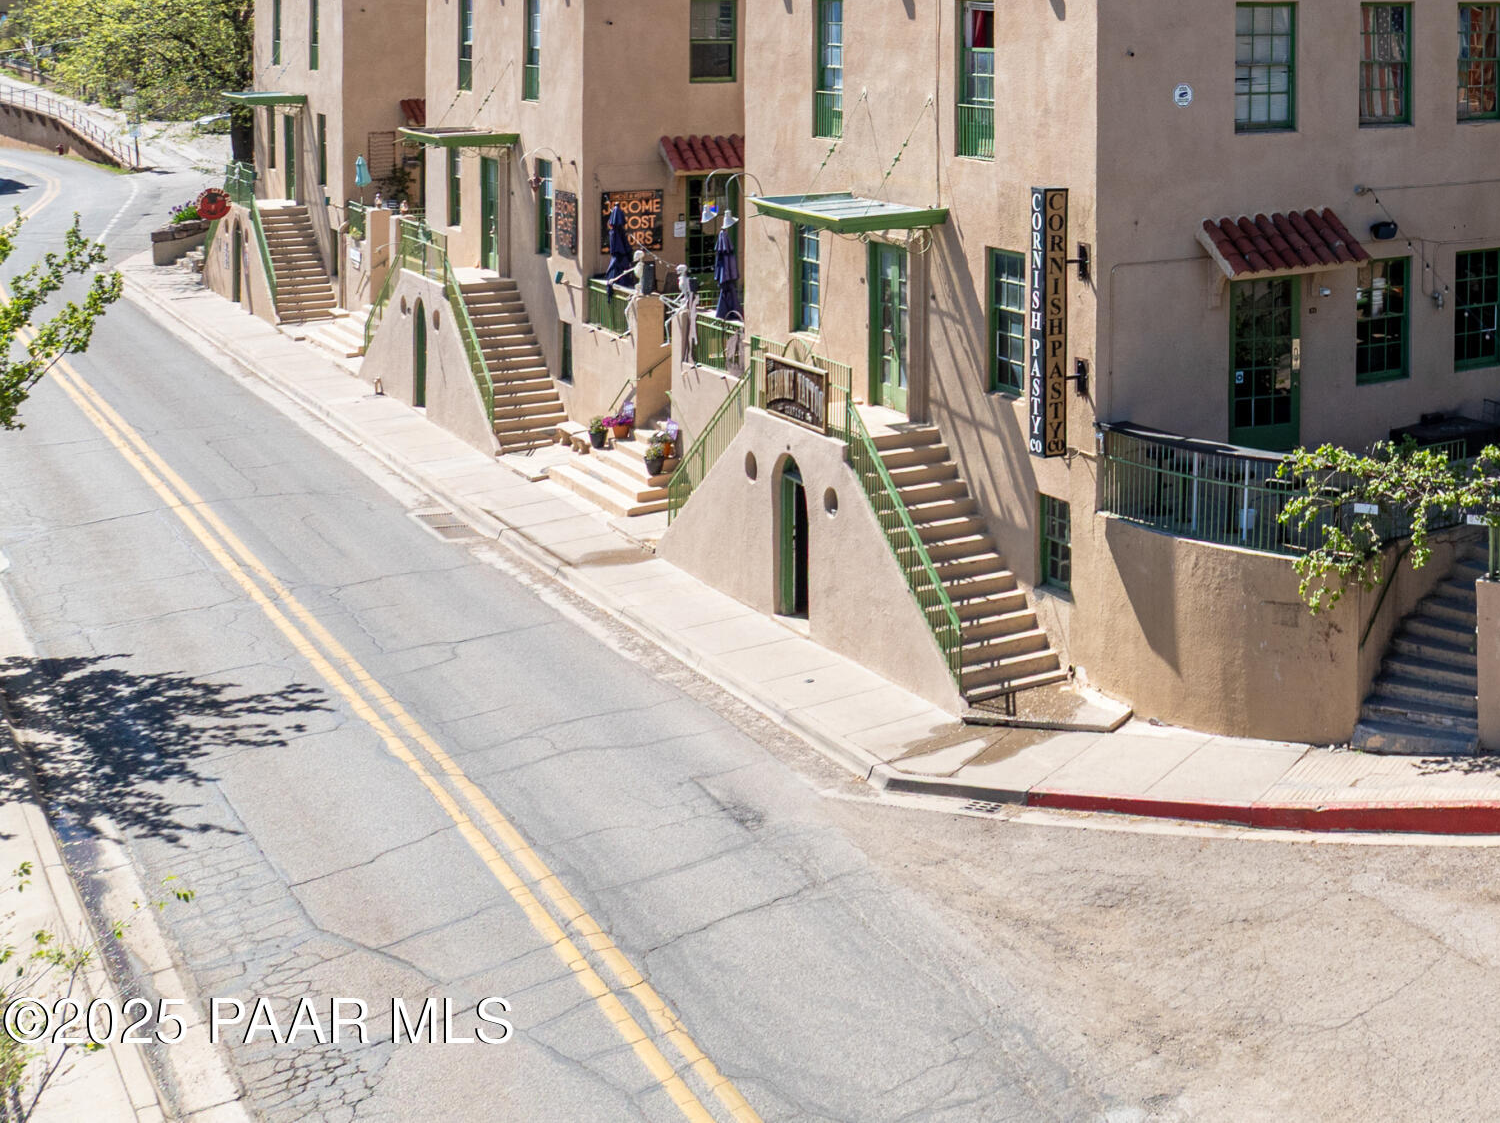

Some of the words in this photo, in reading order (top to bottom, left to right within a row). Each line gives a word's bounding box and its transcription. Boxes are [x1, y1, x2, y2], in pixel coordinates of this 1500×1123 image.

[1031, 193, 1042, 330] CORNISH
[1048, 193, 1064, 335] CORNISH
[1031, 338, 1042, 434] PASTY
[1049, 340, 1063, 439] PASTY
[1030, 438, 1042, 453] CO
[1047, 439, 1065, 453] CO
